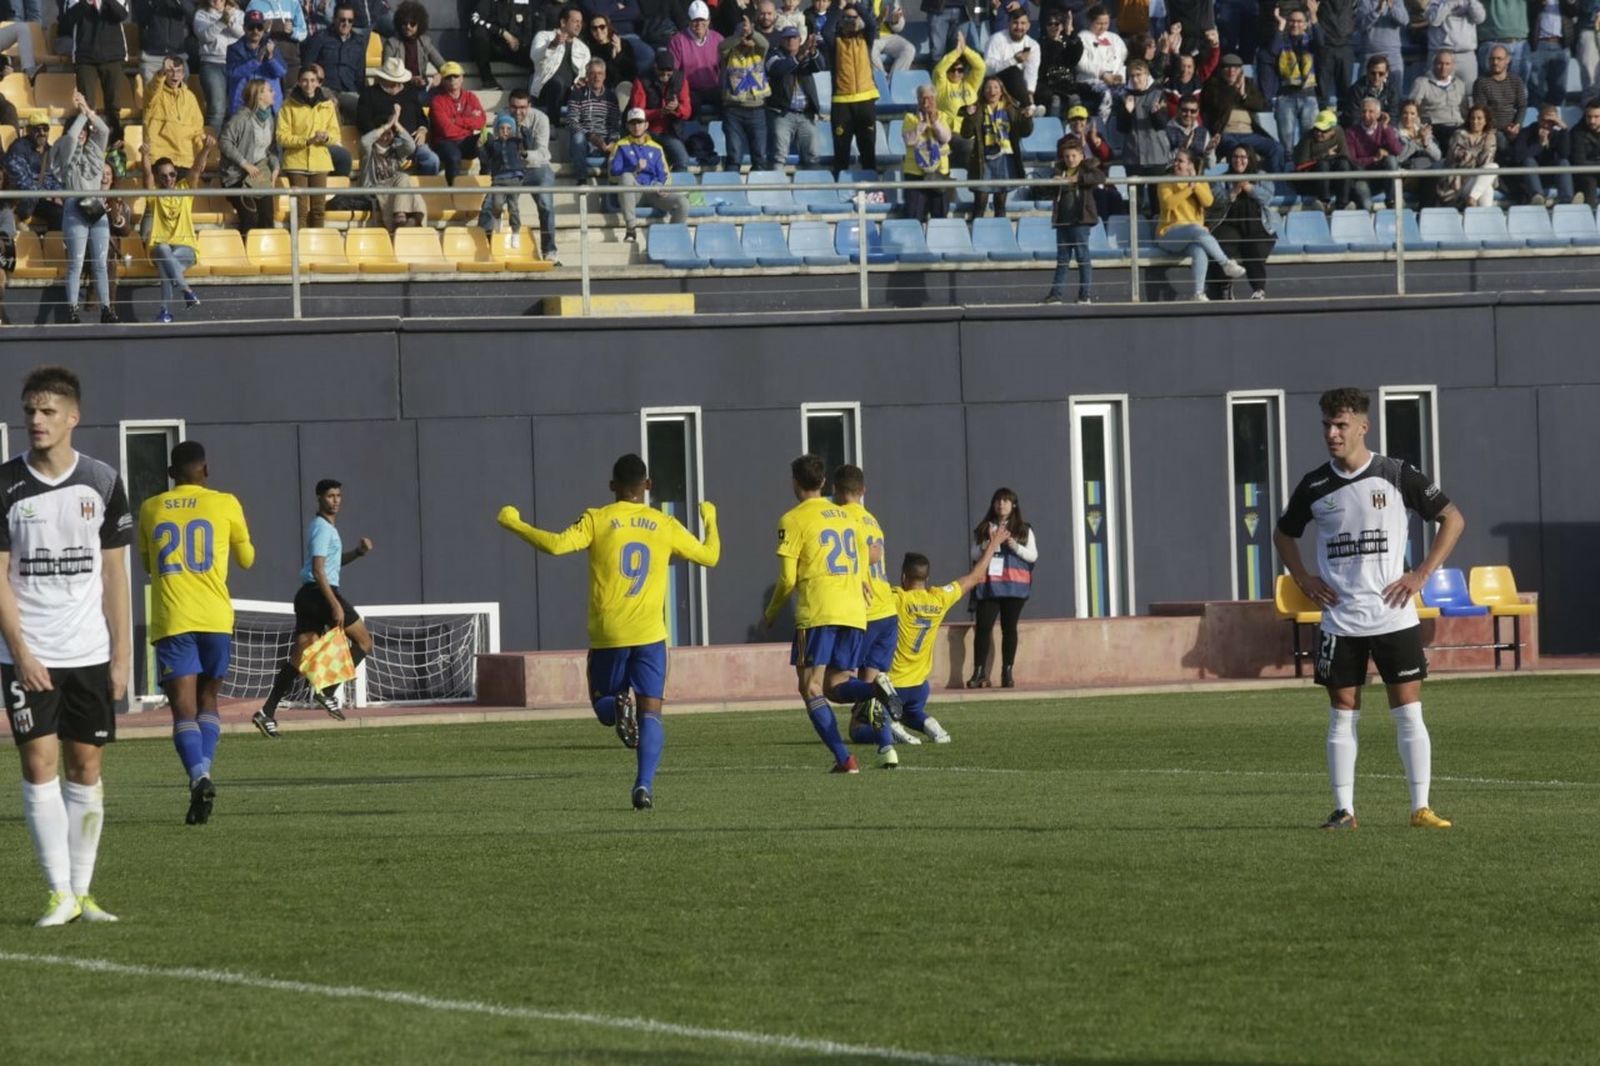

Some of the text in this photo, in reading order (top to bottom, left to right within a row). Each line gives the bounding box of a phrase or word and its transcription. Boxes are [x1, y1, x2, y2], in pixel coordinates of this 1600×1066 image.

[164, 497, 198, 510] SETH
[630, 517, 659, 533] LINO
[153, 518, 215, 576] 20
[819, 528, 860, 576] 29
[620, 541, 652, 598] 9
[914, 617, 932, 654] 7
